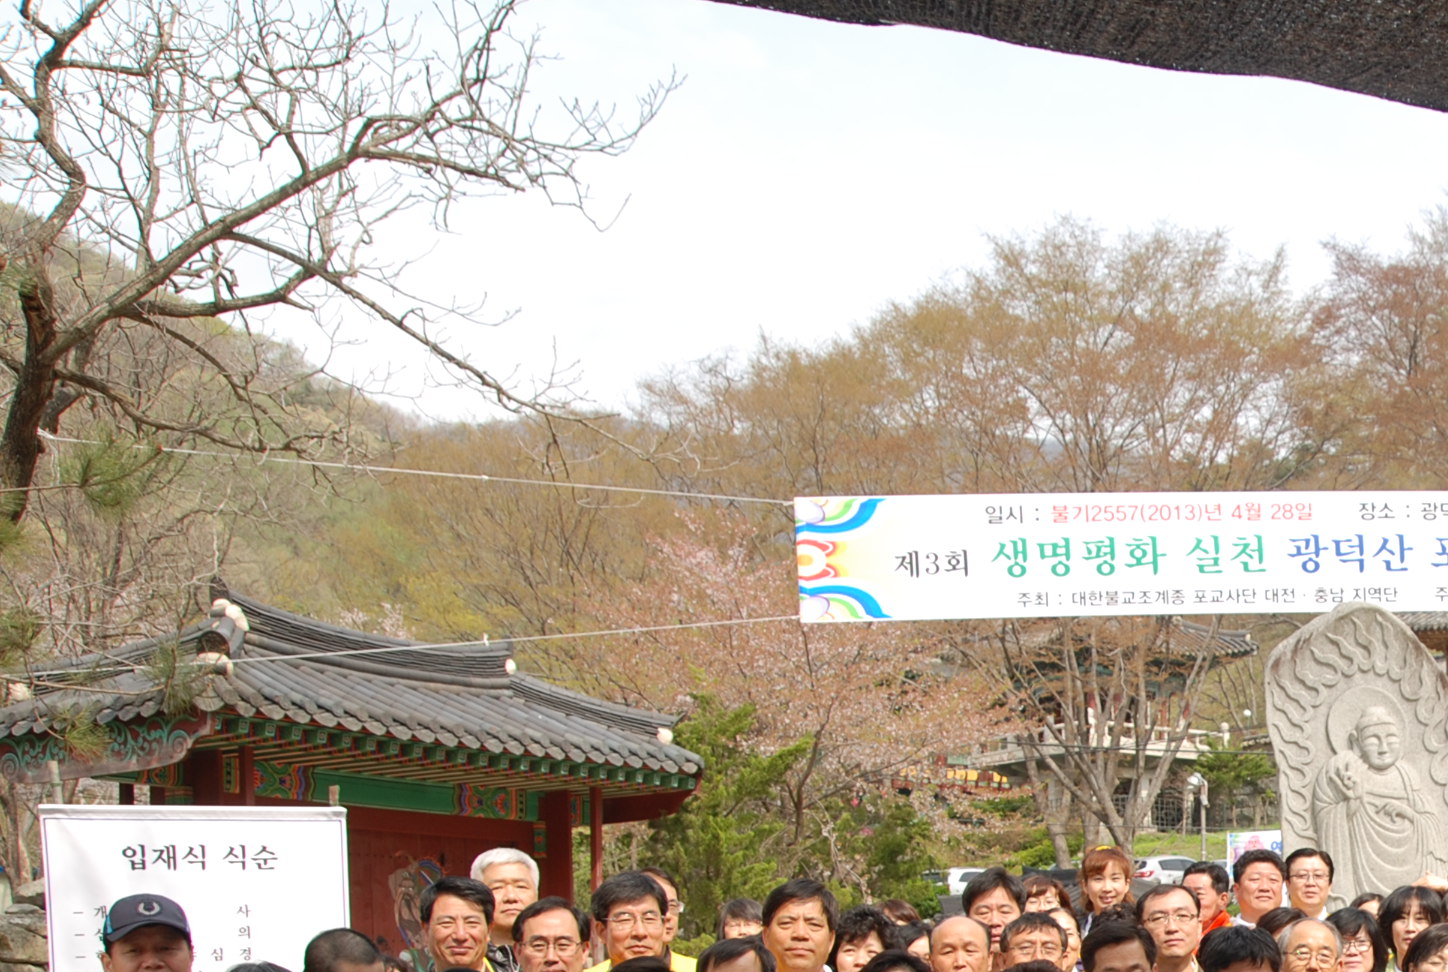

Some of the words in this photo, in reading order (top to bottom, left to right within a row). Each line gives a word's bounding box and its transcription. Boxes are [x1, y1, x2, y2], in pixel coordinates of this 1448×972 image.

[985, 506, 1023, 524] 일시
[1052, 504, 1221, 523] 불기2557(2013)년
[1231, 503, 1261, 521] 4월
[1271, 503, 1312, 520] 28일
[1359, 502, 1395, 520] 장소
[896, 550, 968, 578] 제3회
[992, 536, 1166, 578] 생명평화
[1187, 535, 1266, 573] 실천
[1288, 534, 1413, 573] 광덕산
[1018, 592, 1048, 607] 주최
[1072, 590, 1184, 606] 대한불교조계종
[1194, 588, 1256, 603] 포교사단
[1265, 588, 1294, 603] 대전
[1315, 587, 1344, 603] 충남
[1352, 587, 1398, 603] 지역단
[122, 844, 206, 871] 입재식
[223, 845, 278, 870] 식순
[237, 904, 250, 918] 사
[238, 926, 250, 939] 의
[211, 948, 223, 961] 심
[240, 947, 251, 961] 경
